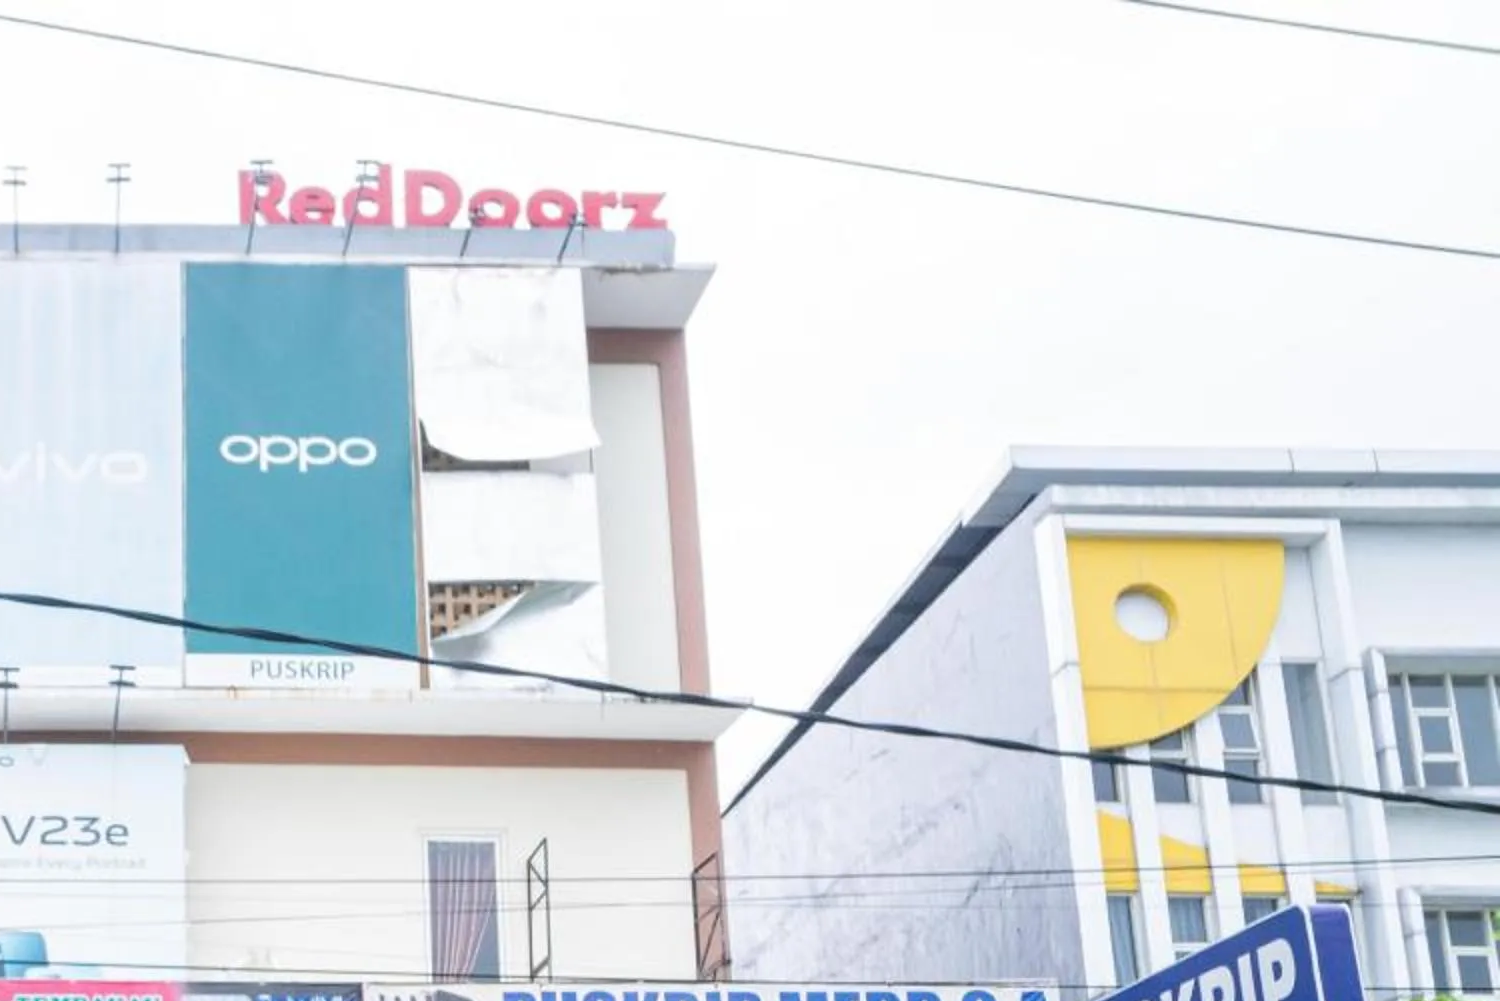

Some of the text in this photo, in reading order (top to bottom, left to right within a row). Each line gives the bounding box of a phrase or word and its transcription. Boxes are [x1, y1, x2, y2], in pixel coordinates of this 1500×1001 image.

[238, 163, 668, 230] RedDoorz
[219, 432, 377, 472] oppo
[250, 660, 355, 681] PUSKRIP
[1, 815, 130, 846] V23e
